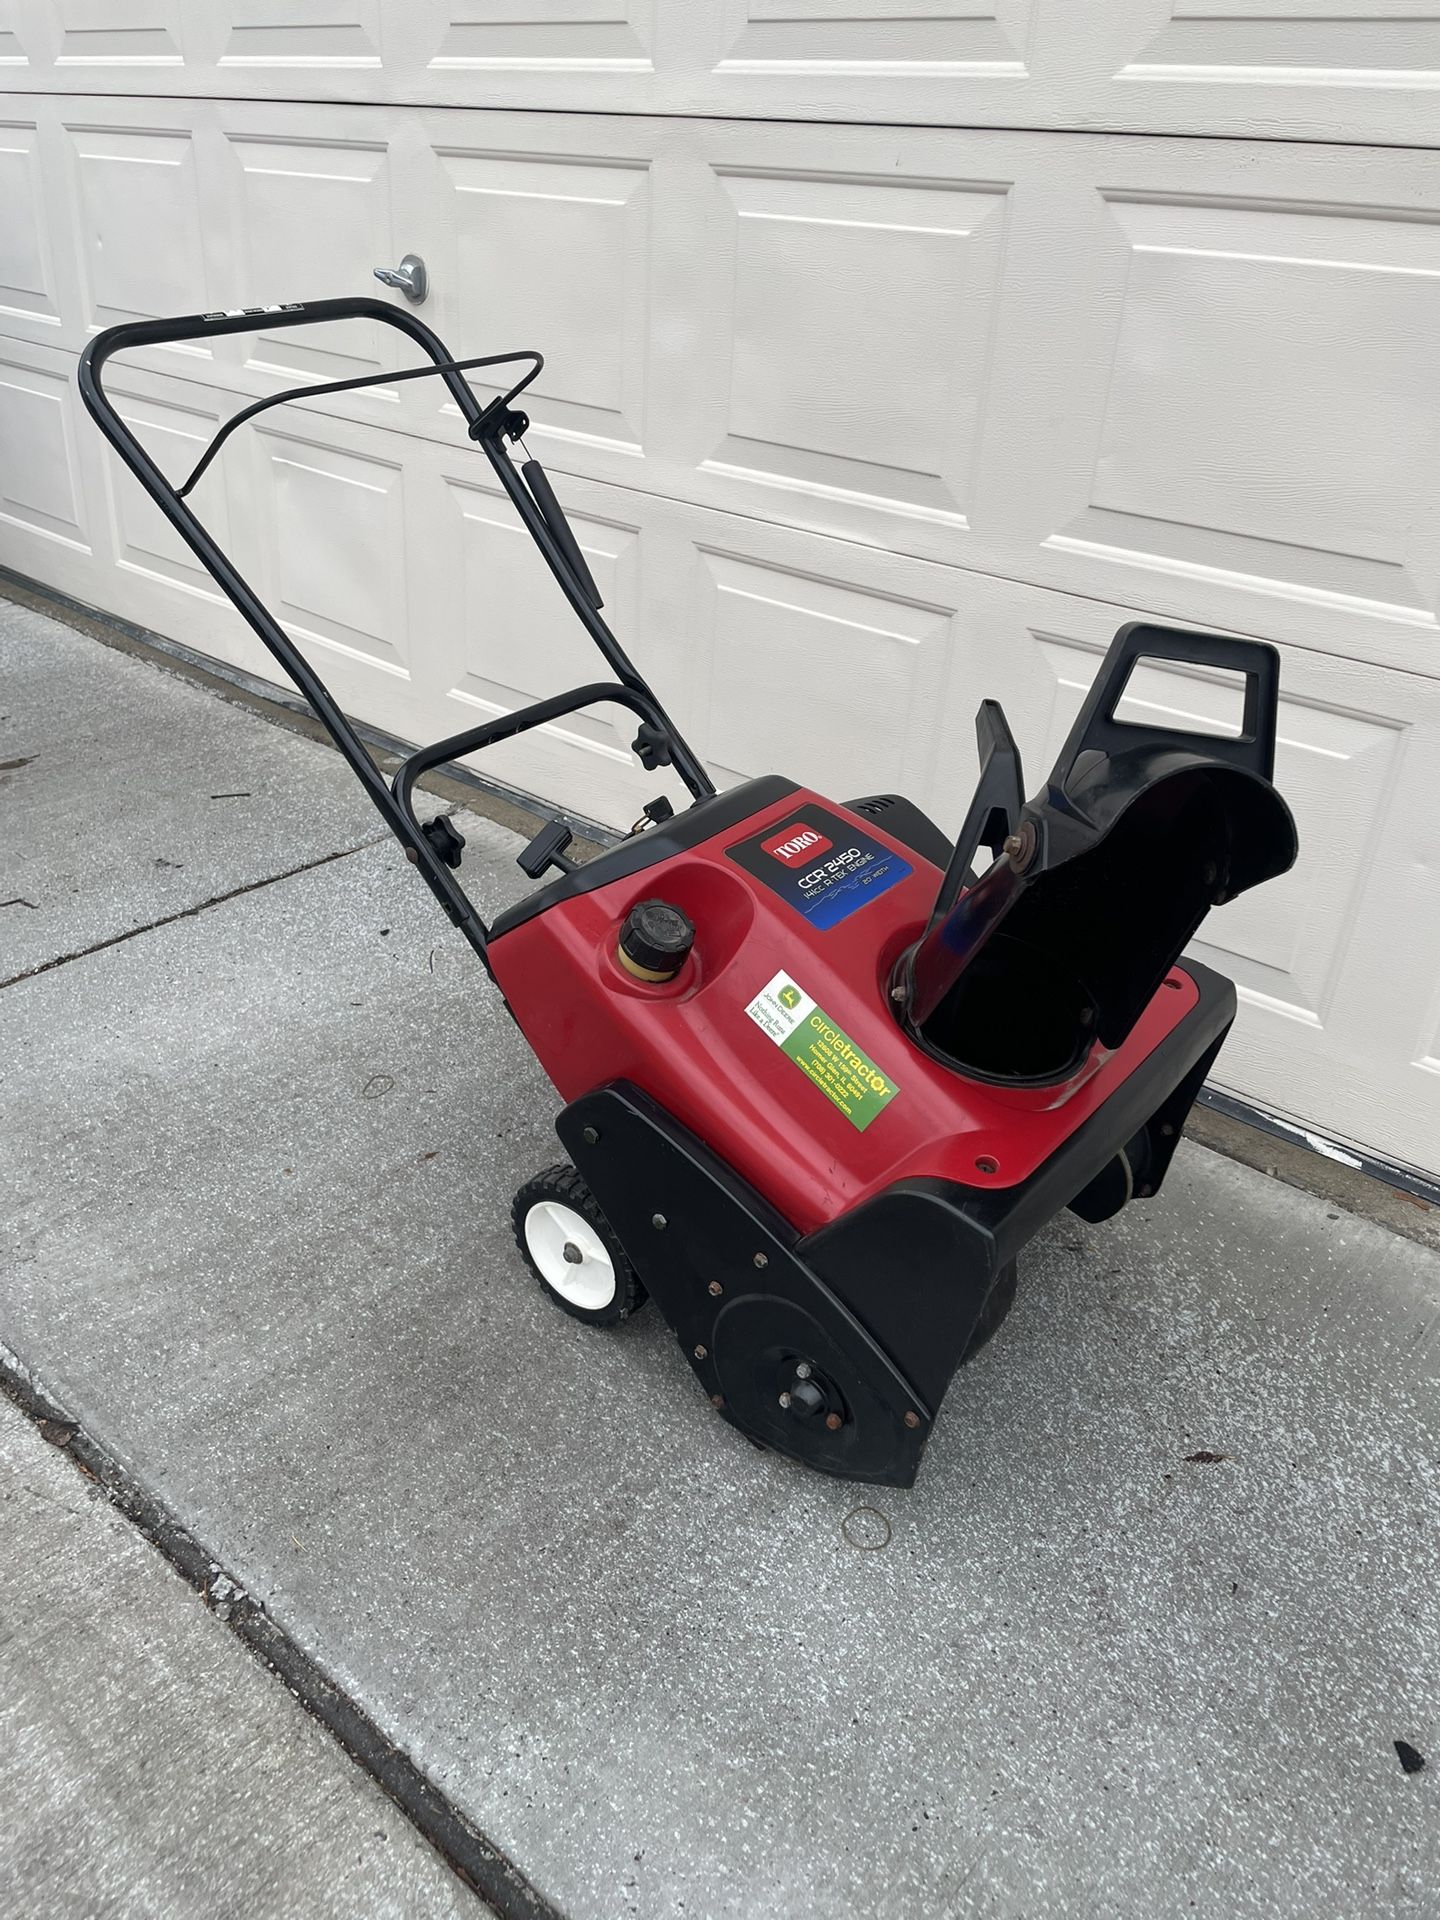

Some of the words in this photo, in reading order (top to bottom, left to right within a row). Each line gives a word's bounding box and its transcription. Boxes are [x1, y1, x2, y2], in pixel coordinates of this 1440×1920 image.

[773, 831, 819, 859] TORO
[798, 869, 828, 889] CCR
[823, 848, 861, 873] 2450
[846, 852, 875, 872] ENGINE
[873, 865, 889, 877] WIDTH
[750, 1006, 761, 1021] Like
[754, 1000, 774, 1023] Nothing
[773, 1019, 786, 1034] Runs
[763, 993, 779, 1009] JOHN
[776, 1005, 796, 1025] DEERE
[809, 1043, 828, 1064] Homer
[826, 1062, 840, 1079] Glen,
[840, 1076, 847, 1085] IL
[810, 1016, 891, 1097] circletractor
[796, 1055, 852, 1115] www.circletractor.com
[824, 1072, 849, 1099] 301-0222
[831, 1054, 840, 1063] W
[851, 1074, 868, 1094] Street
